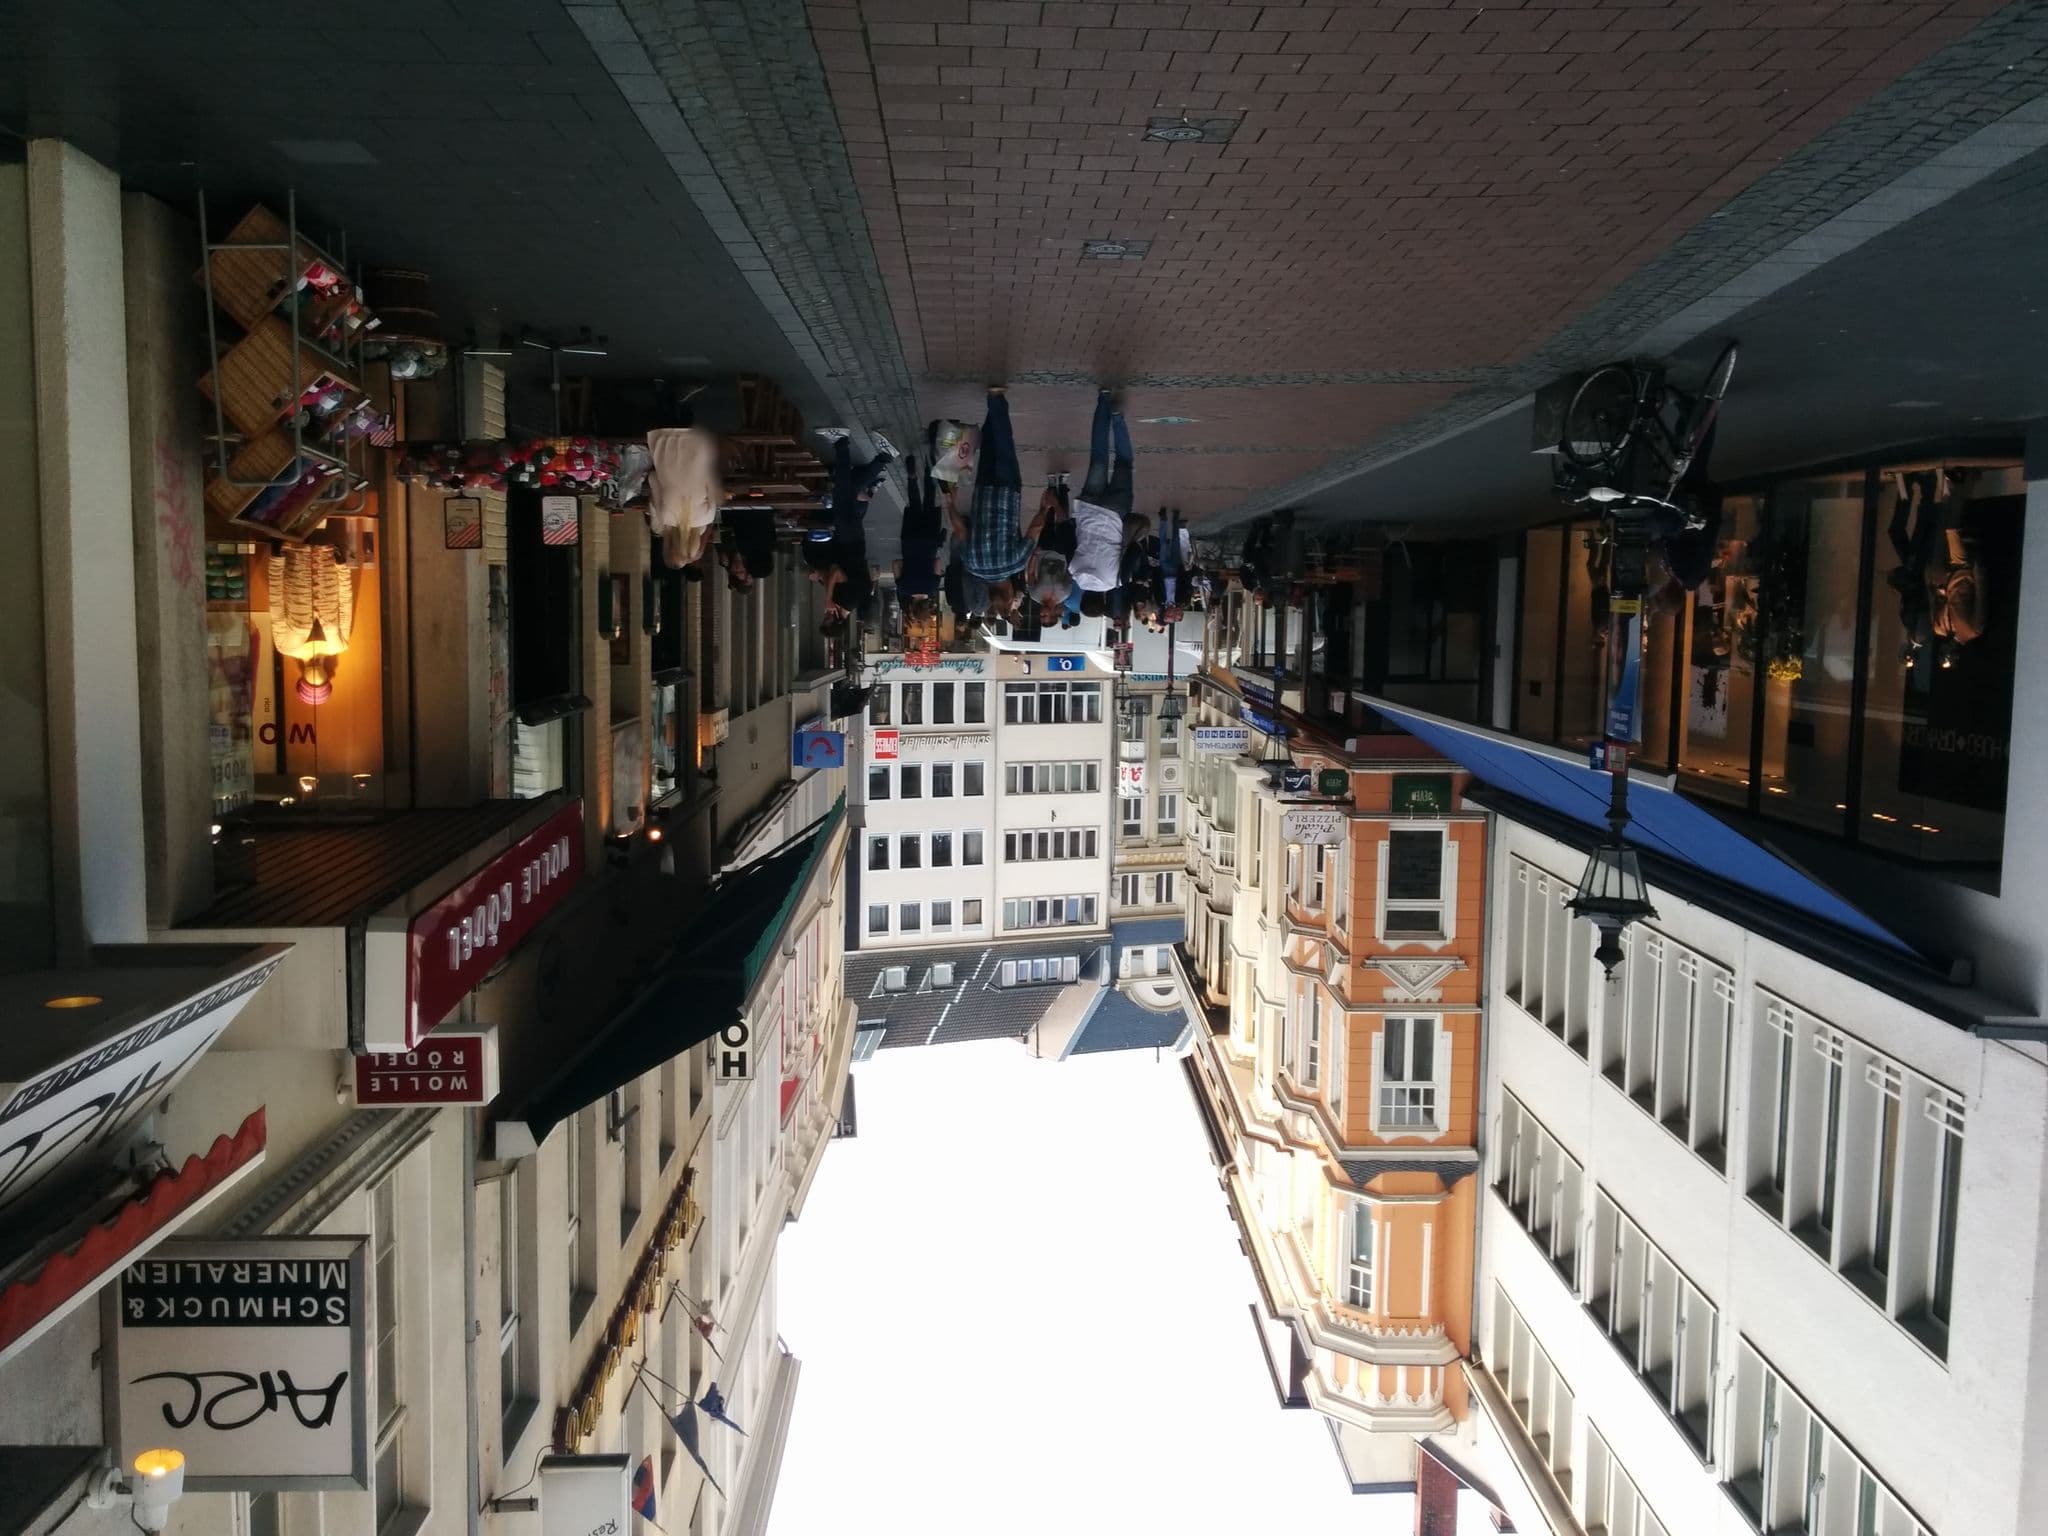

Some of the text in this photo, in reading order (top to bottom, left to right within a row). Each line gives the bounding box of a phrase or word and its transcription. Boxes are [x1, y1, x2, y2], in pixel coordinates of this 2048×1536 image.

[1287, 815, 1342, 824] PIZZERIA
[1295, 823, 1335, 835] Piccola
[448, 835, 570, 971] WOLLE RÖDEL
[5, 1016, 170, 1118] MINERALIEN
[370, 1050, 464, 1069] RÖDEL
[370, 1075, 468, 1092] WOLLE
[127, 1262, 346, 1290] MINERALIEN
[127, 1295, 346, 1325] SCHMUCK &
[129, 1370, 348, 1431] ARC
[587, 1519, 618, 1536] Res
